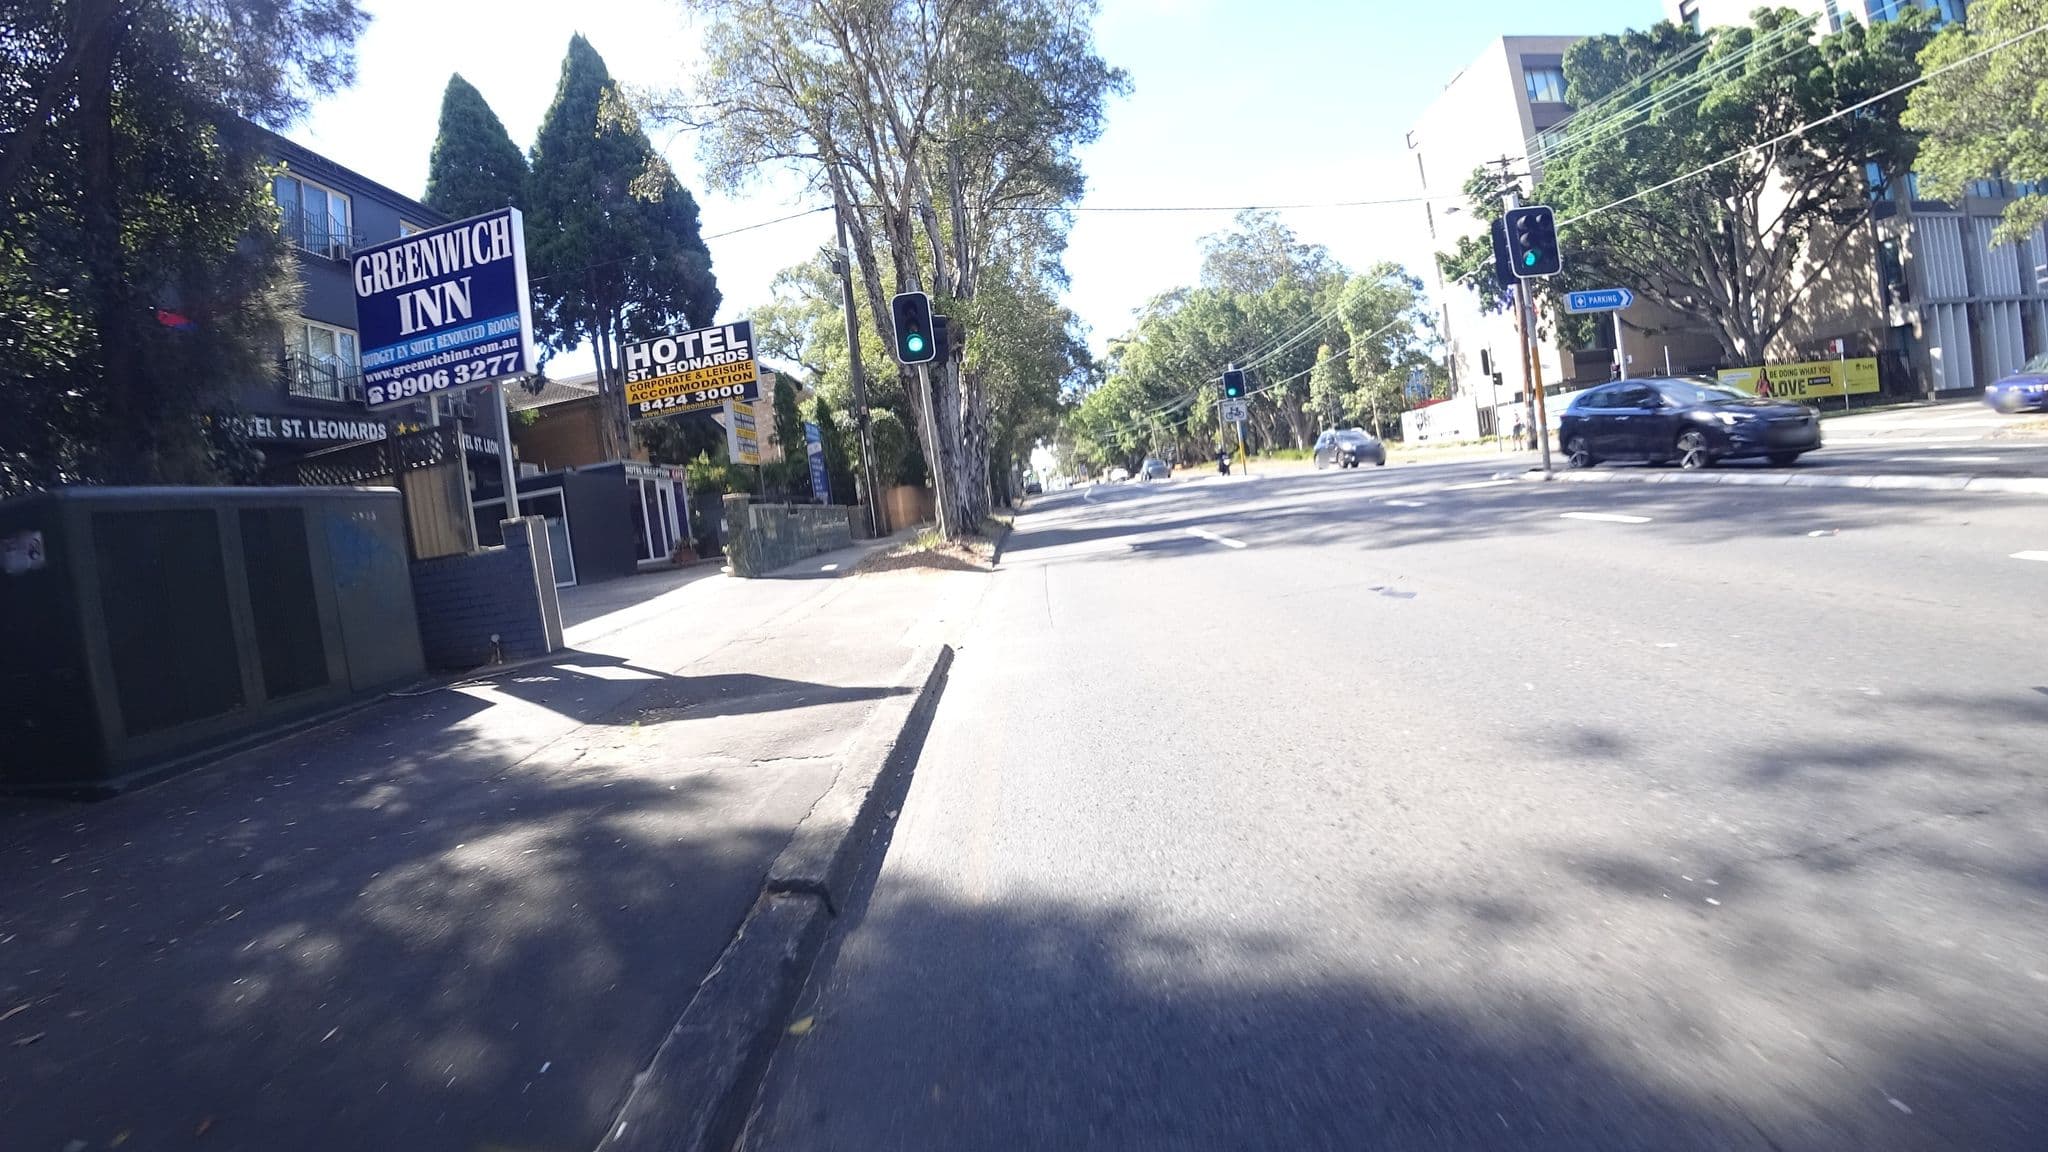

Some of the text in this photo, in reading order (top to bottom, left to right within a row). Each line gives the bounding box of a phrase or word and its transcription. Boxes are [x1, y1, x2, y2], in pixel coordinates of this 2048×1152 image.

[354, 215, 513, 298] GREENWICH
[396, 276, 473, 336] INN
[1588, 295, 1618, 305] PARKING
[363, 344, 395, 367] BUDGET
[410, 337, 435, 356] SUITE
[437, 325, 485, 351] RENOVATED
[487, 315, 520, 335] ROOMS
[625, 325, 748, 370] HOTEL
[365, 337, 518, 383] www.greenwichinn.com.au
[387, 351, 520, 401] 9906 3277
[627, 349, 749, 383] ST. LEONARDS
[629, 361, 753, 392] CORPORATE & LEISURE
[1769, 366, 1831, 378] BE DOING WHAT YOU
[631, 371, 753, 403] ACCOMMODATION
[640, 383, 745, 412] 8424 3000
[1771, 377, 1806, 397] LOVE
[281, 418, 305, 438] ST.
[308, 419, 387, 440] LEONARDS
